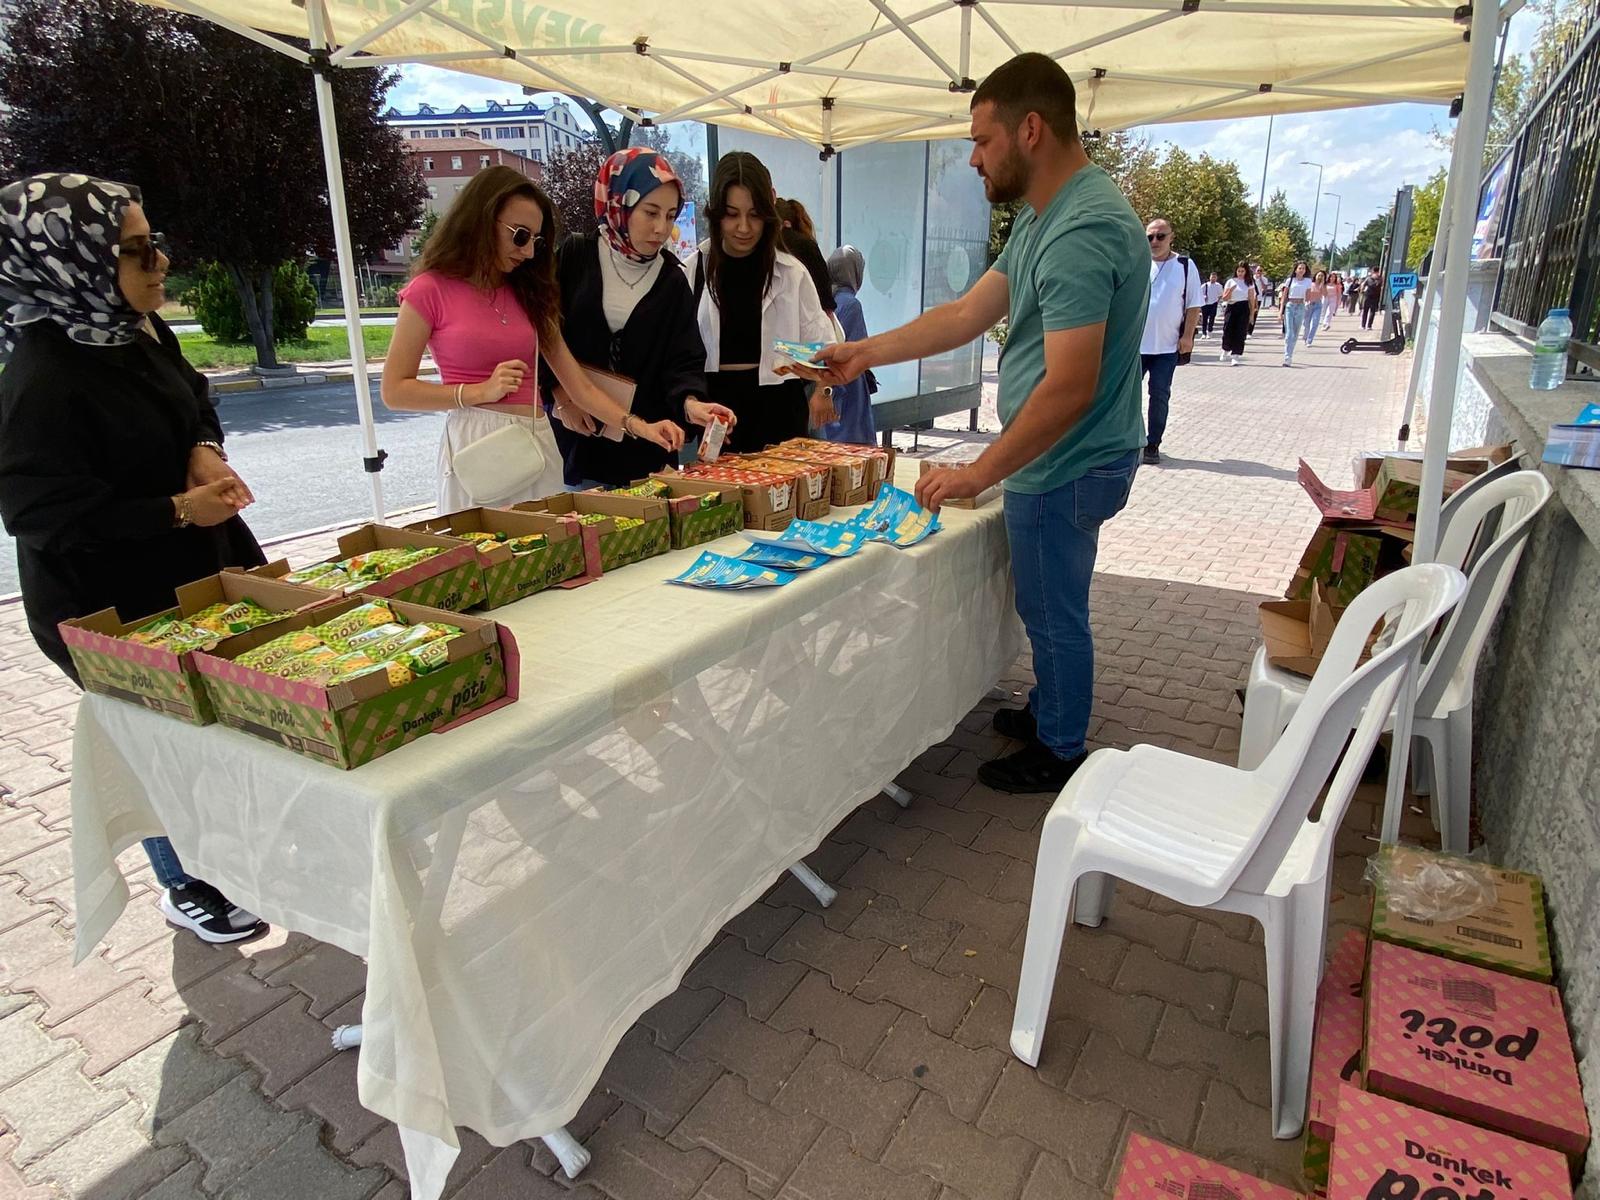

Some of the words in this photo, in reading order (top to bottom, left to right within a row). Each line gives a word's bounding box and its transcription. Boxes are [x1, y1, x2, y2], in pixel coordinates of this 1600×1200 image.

[545, 561, 566, 585] pöti
[484, 653, 493, 666] 5
[269, 706, 296, 727] pöti
[402, 706, 444, 733] Dankek
[451, 675, 488, 716] pöti
[1399, 1008, 1541, 1062] pöti
[1416, 1044, 1514, 1086] Dankek
[1404, 1139, 1514, 1190] Dankek
